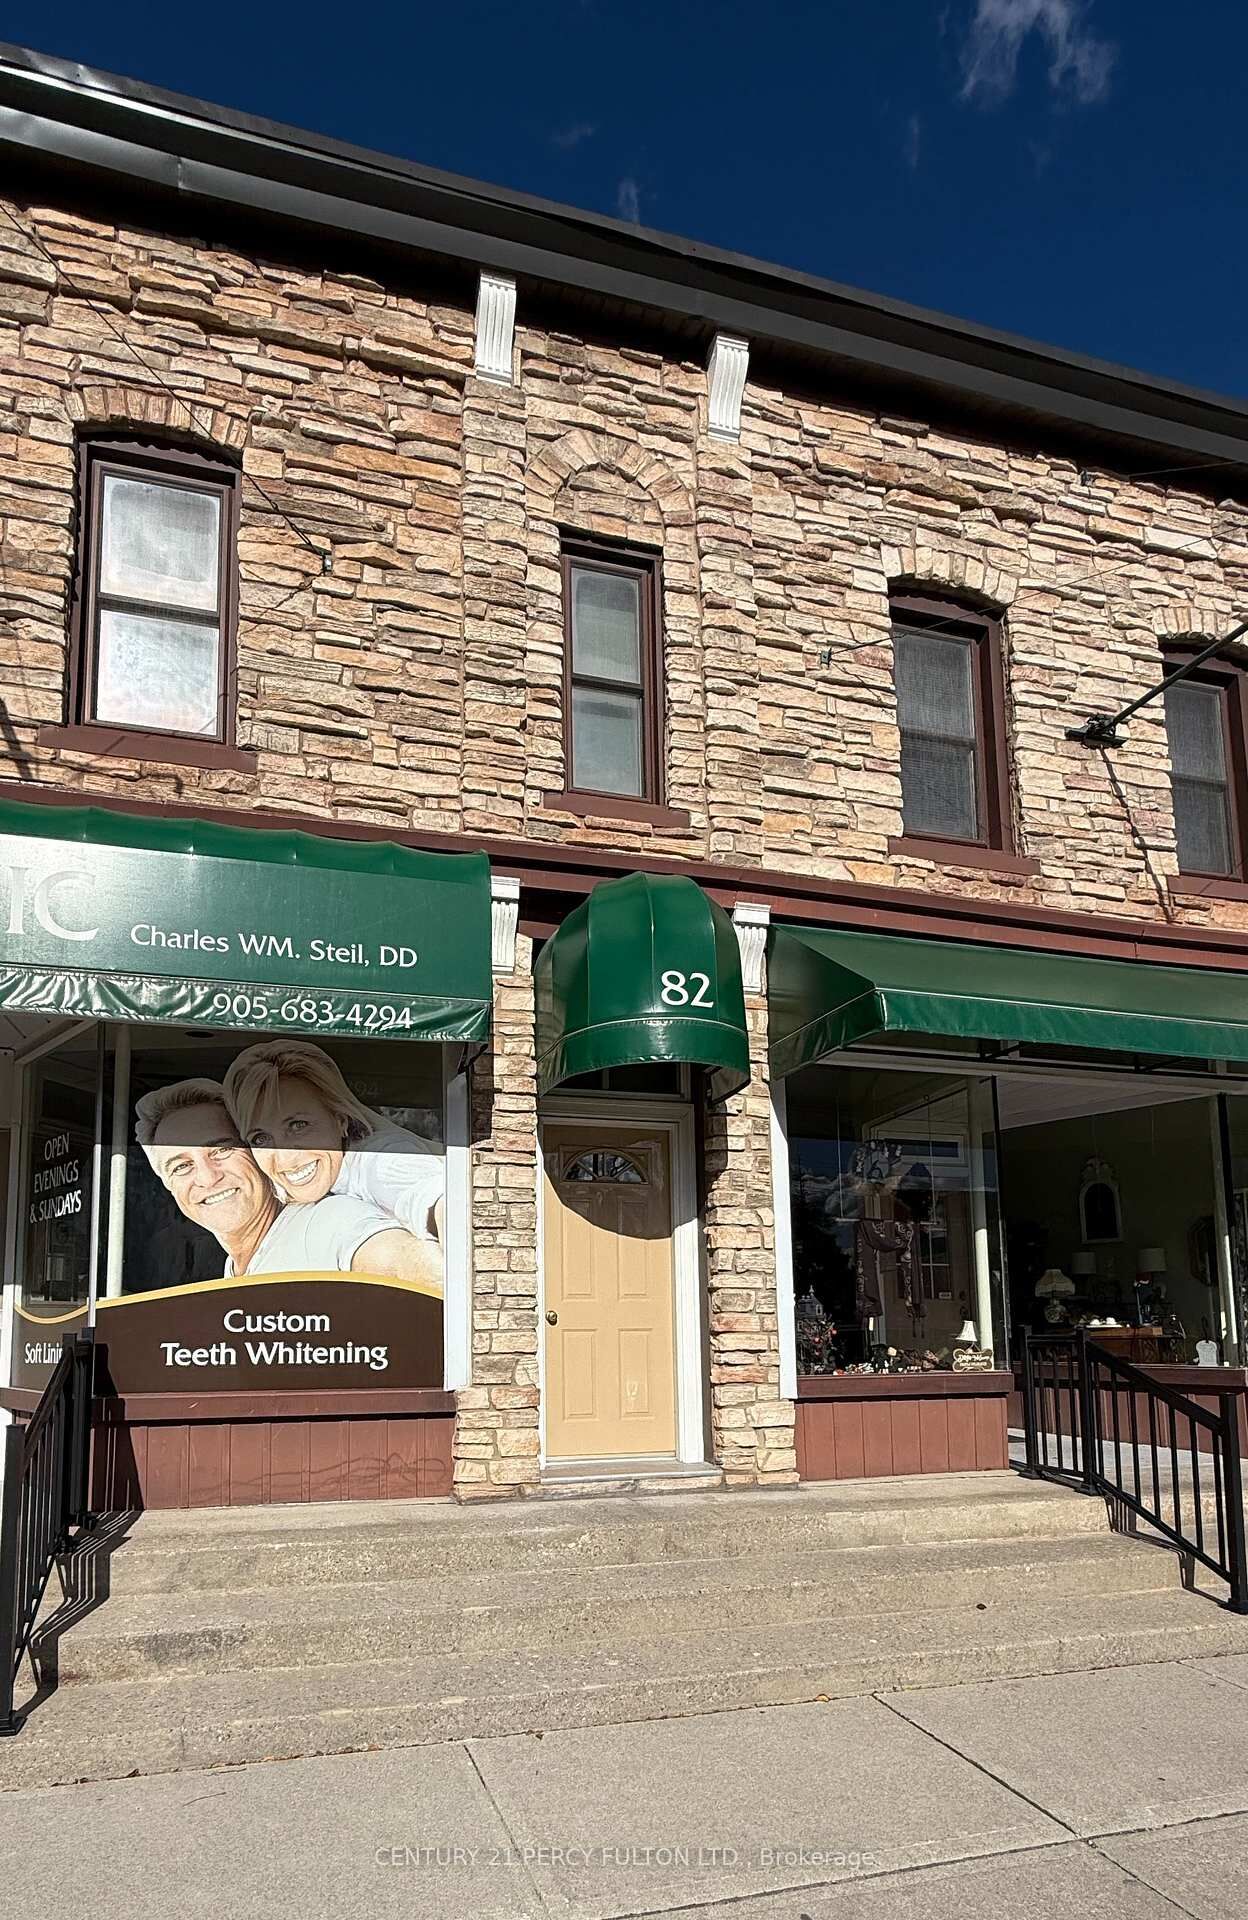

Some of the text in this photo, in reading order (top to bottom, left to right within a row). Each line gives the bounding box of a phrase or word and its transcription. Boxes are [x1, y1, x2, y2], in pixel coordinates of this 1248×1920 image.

[130, 924, 418, 968] Charles WM. Steil, DD
[660, 970, 714, 1008] 82
[213, 993, 414, 1031] 905-683-4294
[44, 1132, 70, 1161] OPEN
[34, 1159, 79, 1193] EVENINGS
[29, 1189, 82, 1224] & SUNDAYS
[223, 1309, 330, 1333] Custom
[24, 1342, 42, 1364] Soft
[160, 1341, 389, 1371] Teeth Whitening
